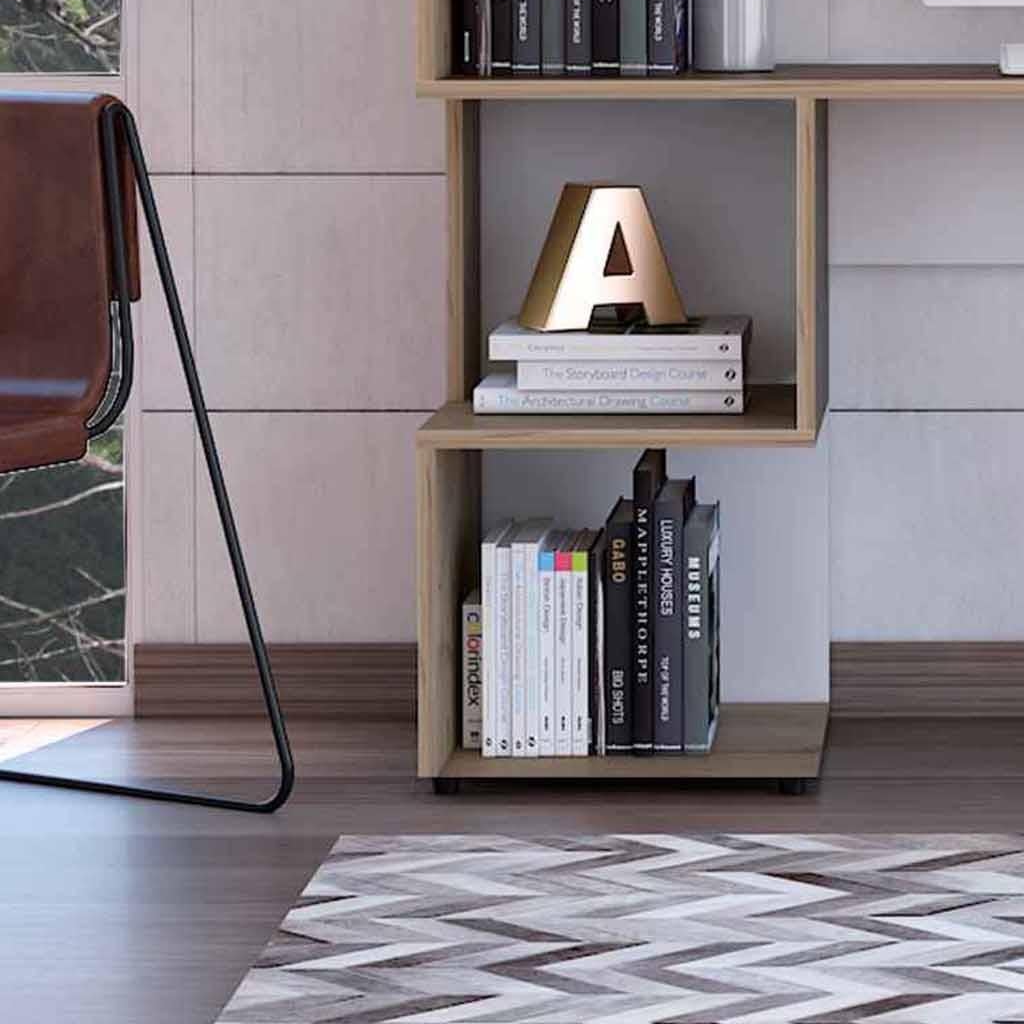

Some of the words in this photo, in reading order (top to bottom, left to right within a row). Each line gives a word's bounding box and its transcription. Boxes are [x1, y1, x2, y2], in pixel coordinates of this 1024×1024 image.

[612, 539, 626, 583] GABO
[659, 519, 674, 566] LUXURY
[636, 508, 648, 684] MAPPLETHORPE
[659, 568, 674, 616] HOUSES
[687, 557, 701, 639] MUSEUMS
[612, 690, 624, 724] SHOTS
